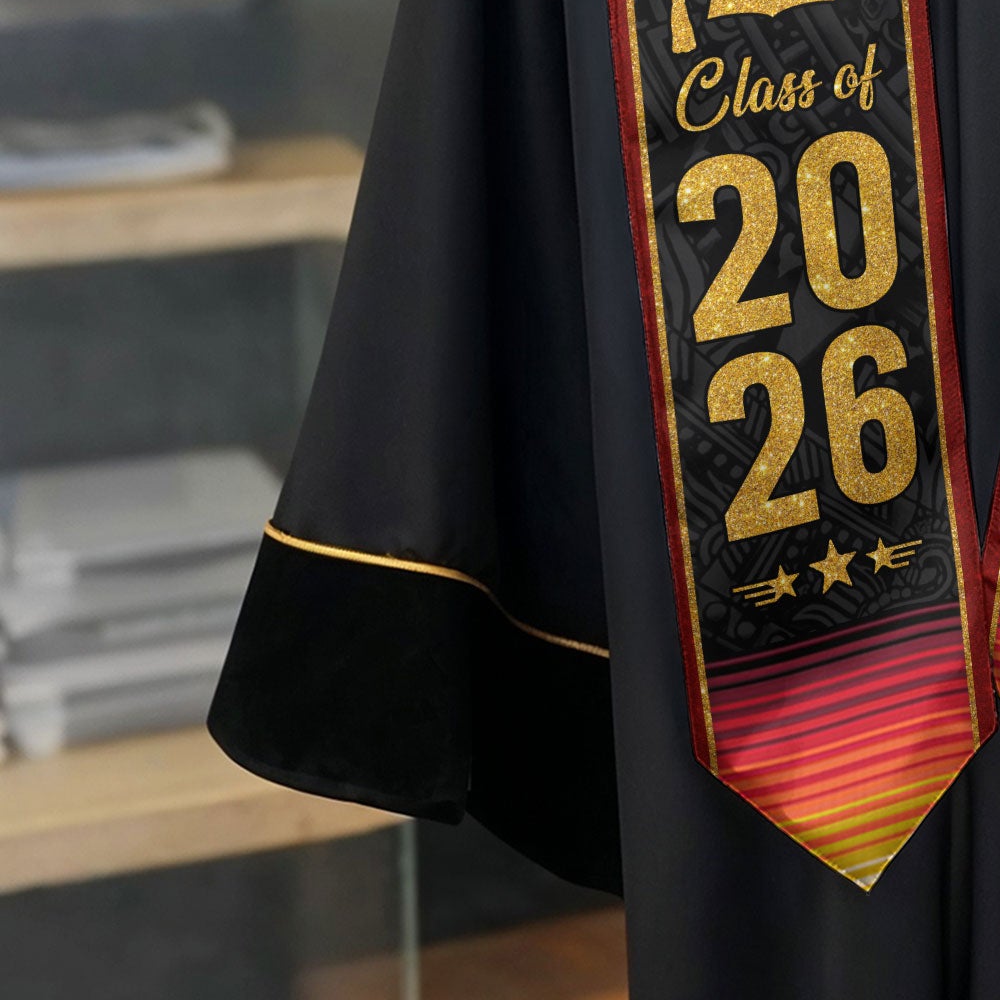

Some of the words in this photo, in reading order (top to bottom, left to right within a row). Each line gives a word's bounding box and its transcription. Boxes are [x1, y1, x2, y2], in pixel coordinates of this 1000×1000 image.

[676, 56, 822, 132] Class
[834, 43, 882, 111] of
[676, 131, 898, 342] 20
[707, 325, 917, 542] 26
